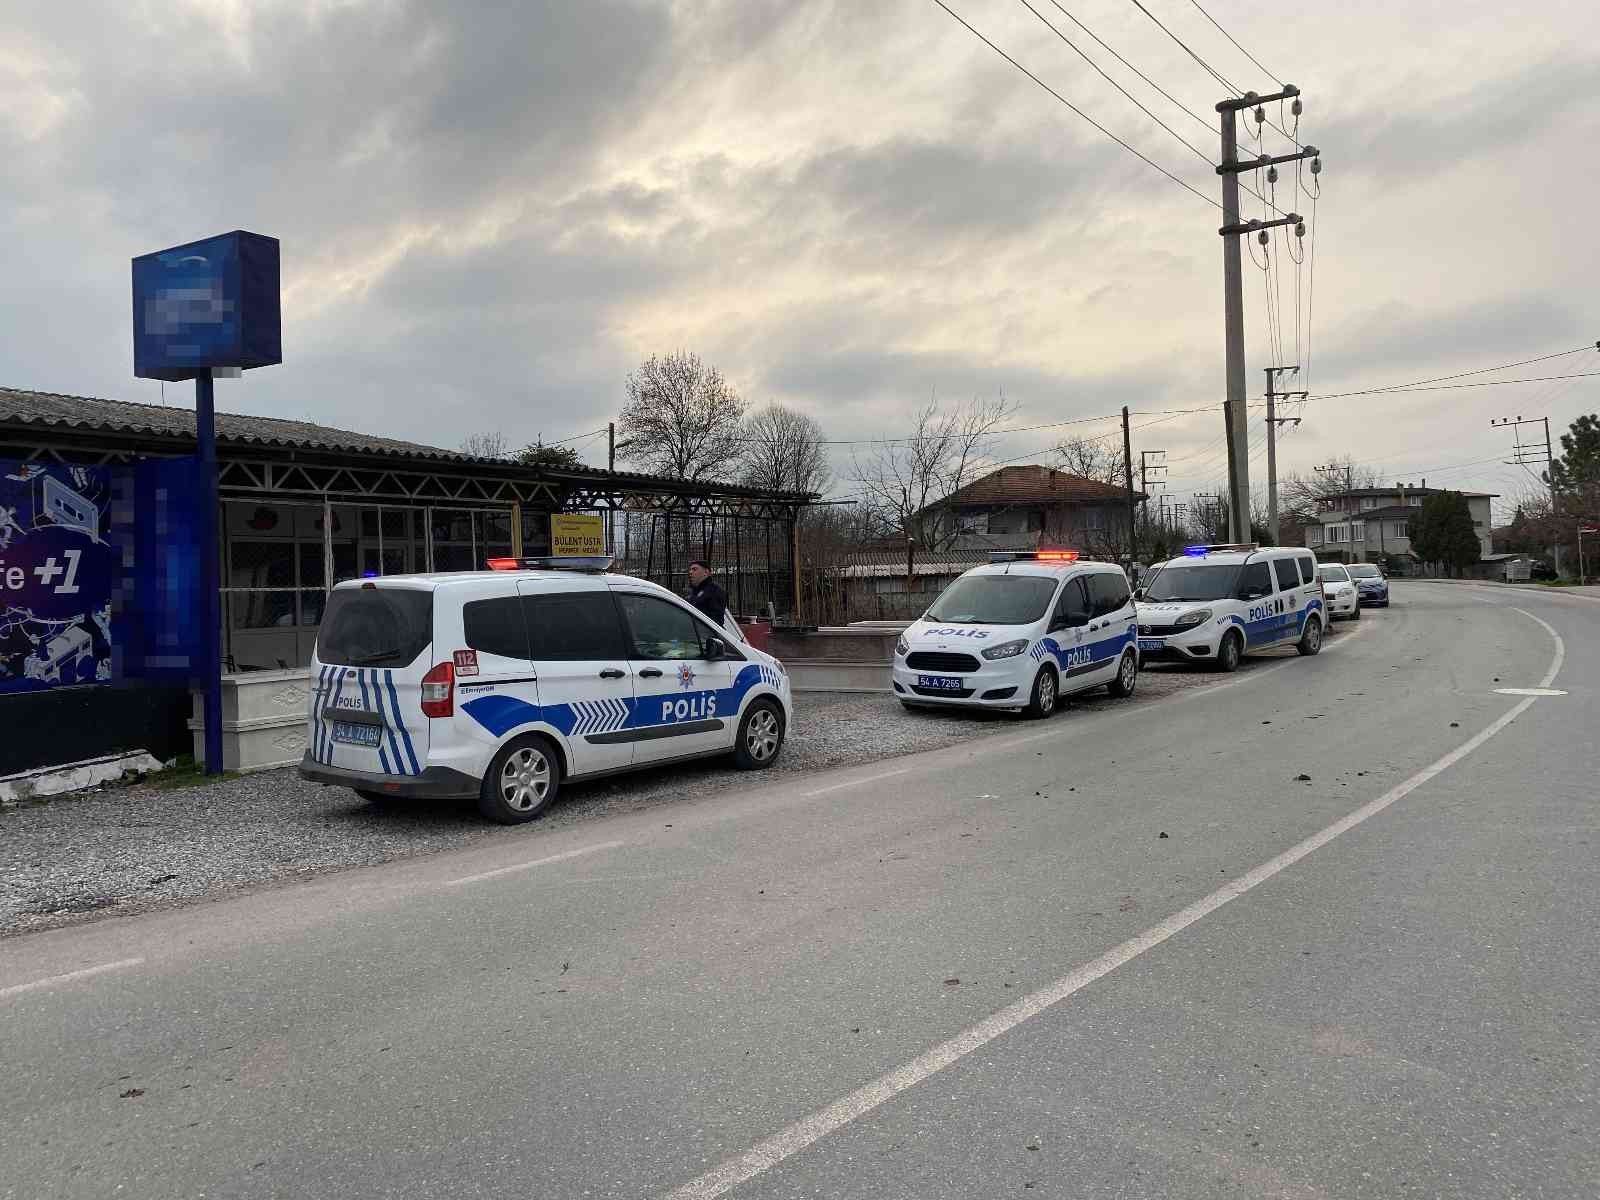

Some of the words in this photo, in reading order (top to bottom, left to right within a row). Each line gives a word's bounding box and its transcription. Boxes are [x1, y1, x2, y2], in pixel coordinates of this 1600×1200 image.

[33, 549, 82, 594] +1
[1249, 600, 1274, 621] POLİS
[924, 627, 991, 639] POLİS
[456, 652, 475, 666] 112
[1067, 646, 1092, 667] POLİS
[920, 677, 931, 688] 54
[932, 679, 940, 688] A
[338, 695, 361, 709] POLİS
[661, 691, 717, 721] POLİS
